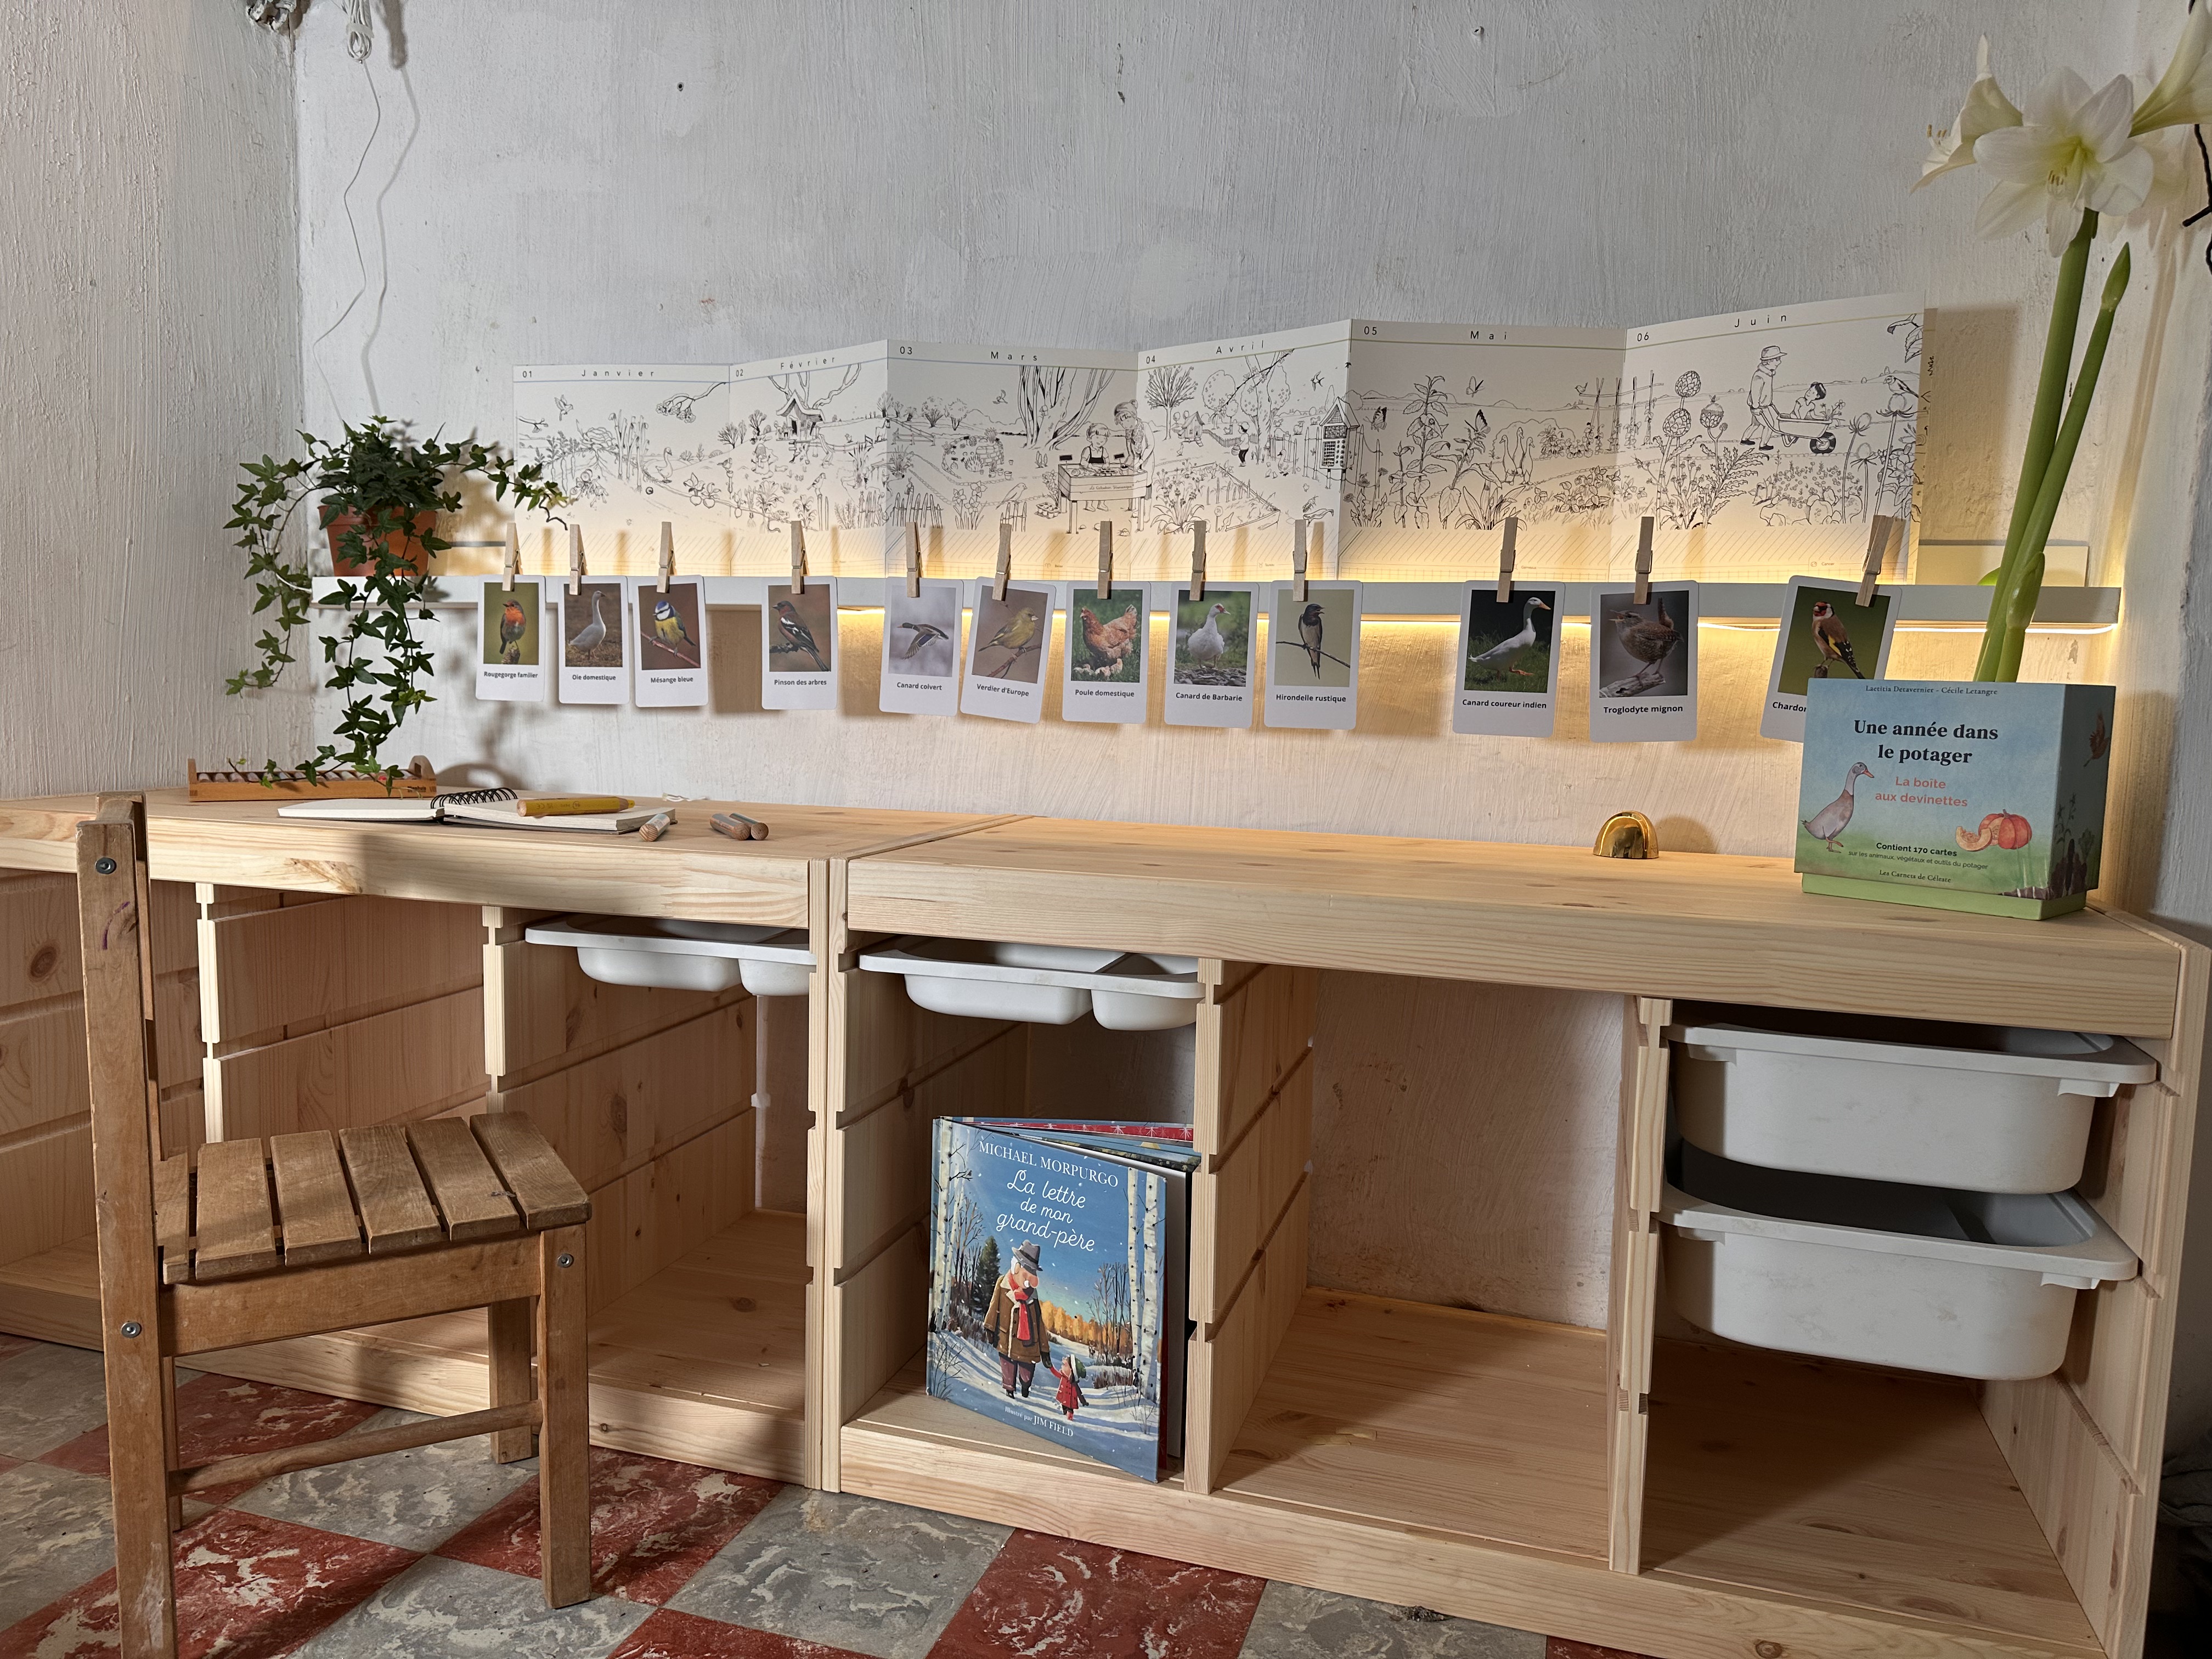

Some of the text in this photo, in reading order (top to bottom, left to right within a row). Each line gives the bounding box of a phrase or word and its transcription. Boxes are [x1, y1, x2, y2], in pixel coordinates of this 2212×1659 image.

[1364, 326, 1507, 340] 05 Mai
[1637, 314, 1787, 342] 06 Juin
[899, 346, 1037, 361] 03 Mars
[1146, 340, 1264, 364] 04 Avril
[736, 356, 835, 377] 02 Février
[977, 684, 1029, 697] Verdier d'Europe
[1095, 690, 1135, 698] domestique
[1966, 688, 1997, 696] Letangre
[1315, 695, 1346, 703] rustique
[1604, 706, 1683, 715] Troglodyte mignon
[1854, 720, 1999, 740] Une année dans
[1878, 744, 1972, 766] le potager
[1895, 776, 1946, 789] La boîte
[1875, 793, 1968, 807] aux devinettes
[1876, 842, 1911, 852] Contient
[1930, 849, 1957, 857] cartes
[1891, 871, 1916, 879] Carnets
[1927, 874, 1951, 883] Céleste
[979, 1141, 1119, 1188] MICHAEL MORPURGO
[1007, 1169, 1086, 1209] La lettre
[1020, 1198, 1073, 1224] de mon
[996, 1212, 1096, 1252] grand-père
[1005, 1406, 1023, 1418] Illustré
[1033, 1415, 1047, 1427] JIM
[1049, 1421, 1074, 1437] FIELD
